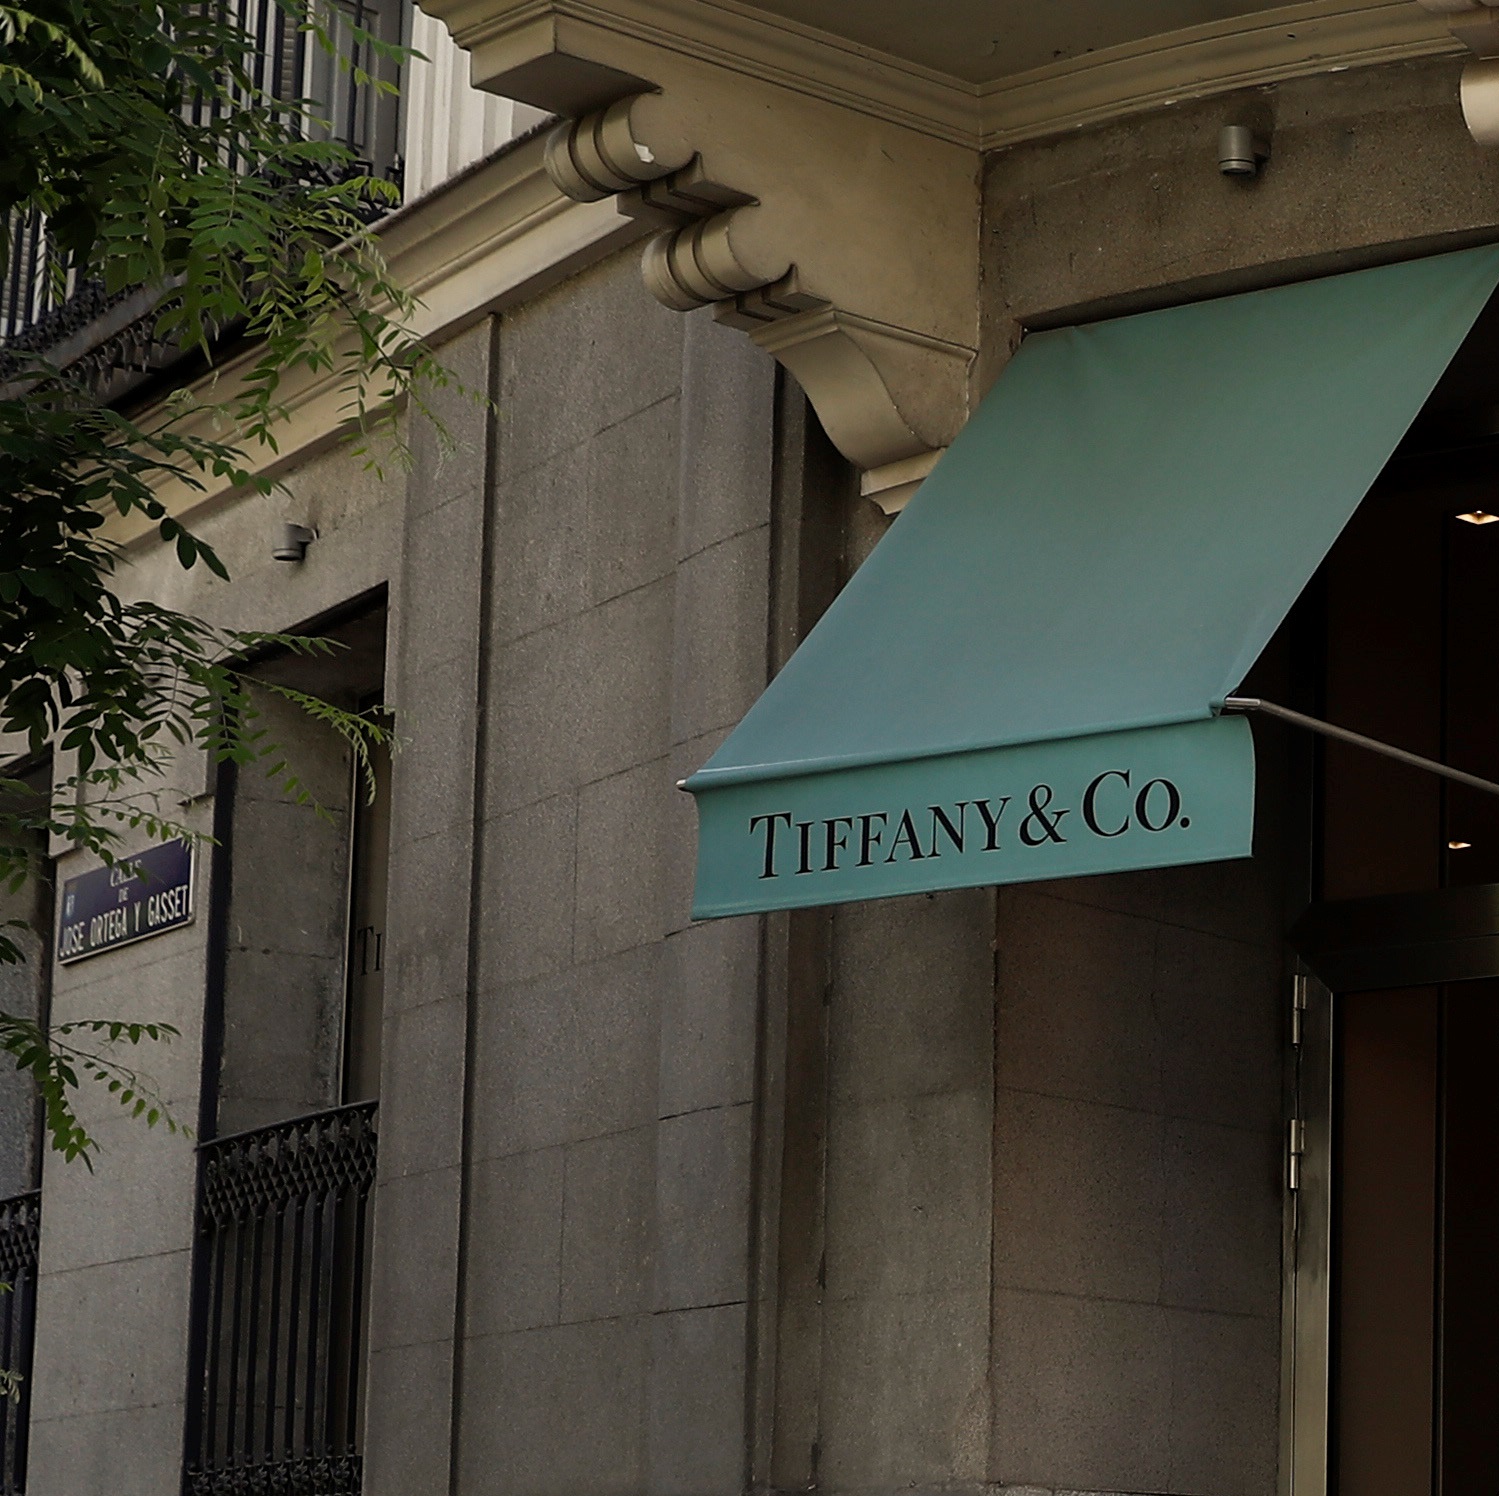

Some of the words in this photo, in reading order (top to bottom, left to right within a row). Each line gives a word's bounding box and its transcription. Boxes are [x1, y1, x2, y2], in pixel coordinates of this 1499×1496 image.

[118, 886, 129, 903] DE
[90, 906, 128, 947] ORTEGA
[134, 901, 141, 932] Y
[147, 884, 188, 927] GASSET
